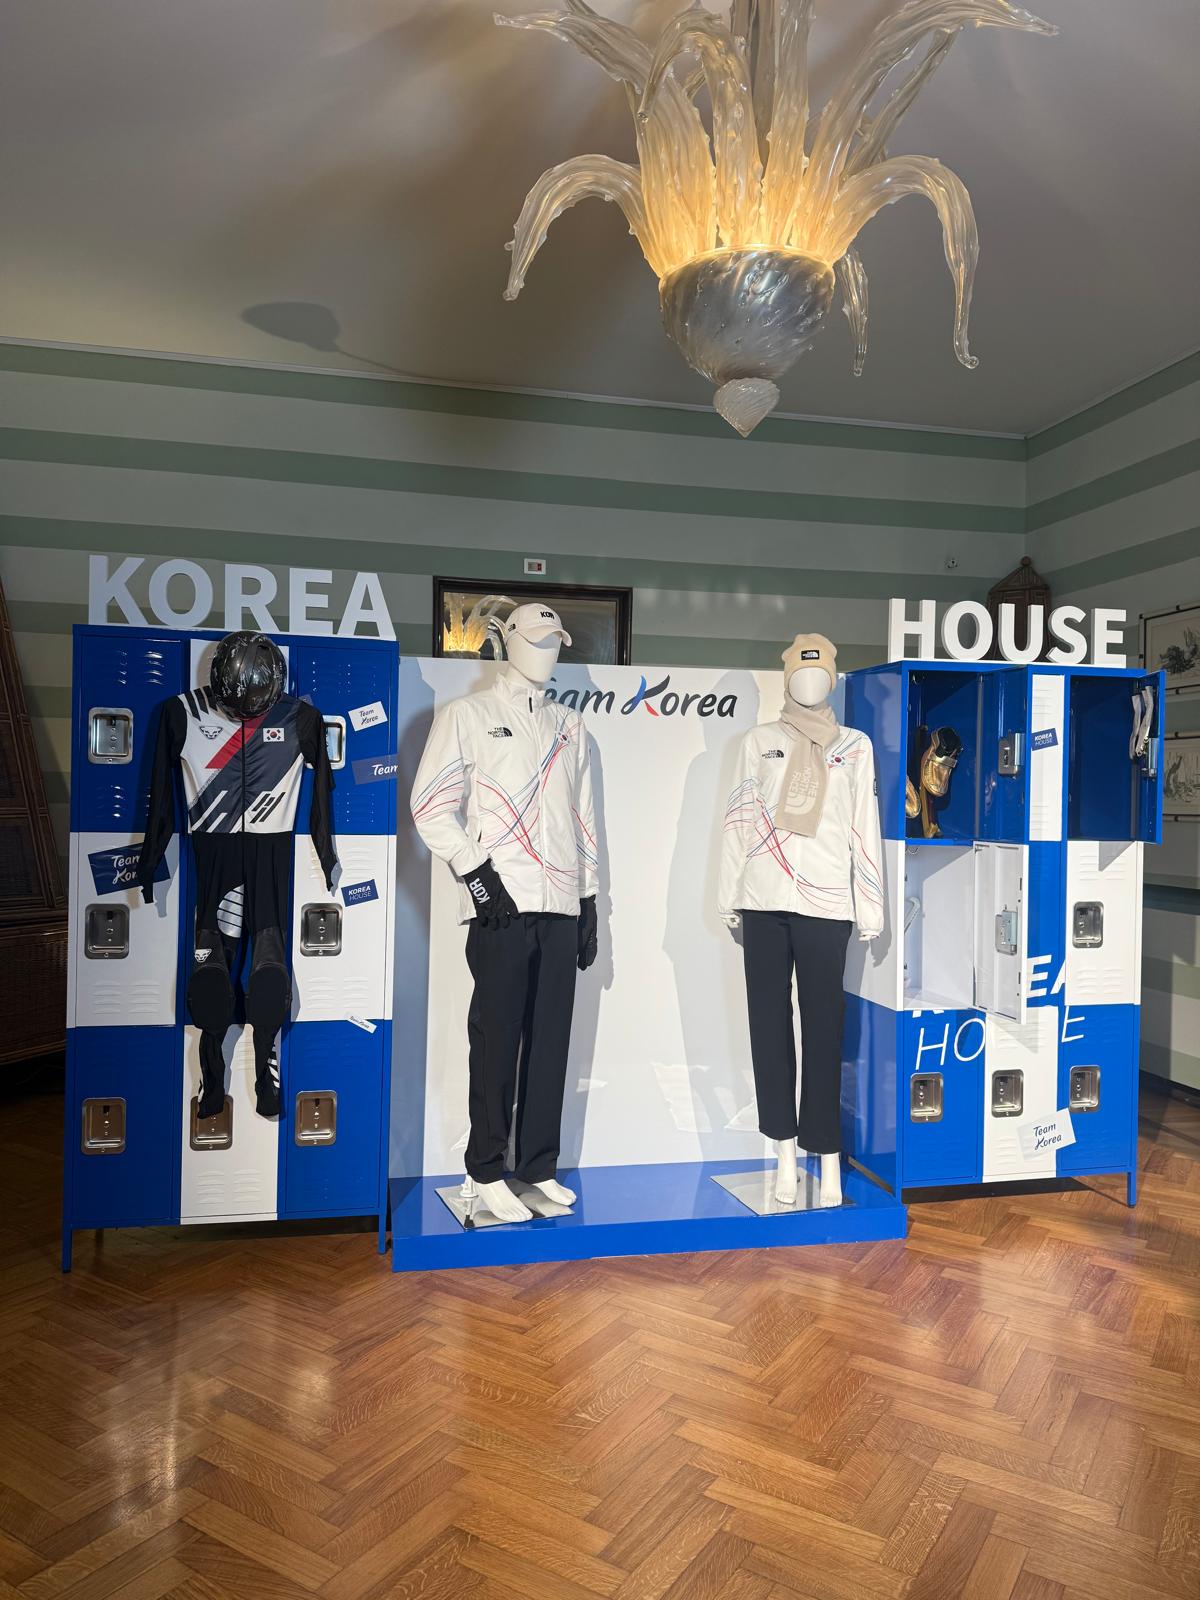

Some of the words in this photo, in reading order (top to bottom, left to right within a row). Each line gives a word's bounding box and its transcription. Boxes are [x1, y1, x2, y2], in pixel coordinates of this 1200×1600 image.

[88, 554, 397, 641] KOREA
[887, 597, 1127, 668] HOUSE
[620, 673, 738, 717] Korea
[112, 867, 138, 885] Kor
[348, 885, 371, 896] KOREA
[469, 877, 490, 904] KOR
[1033, 1123, 1056, 1137] Team
[1034, 1134, 1062, 1151] Korea
